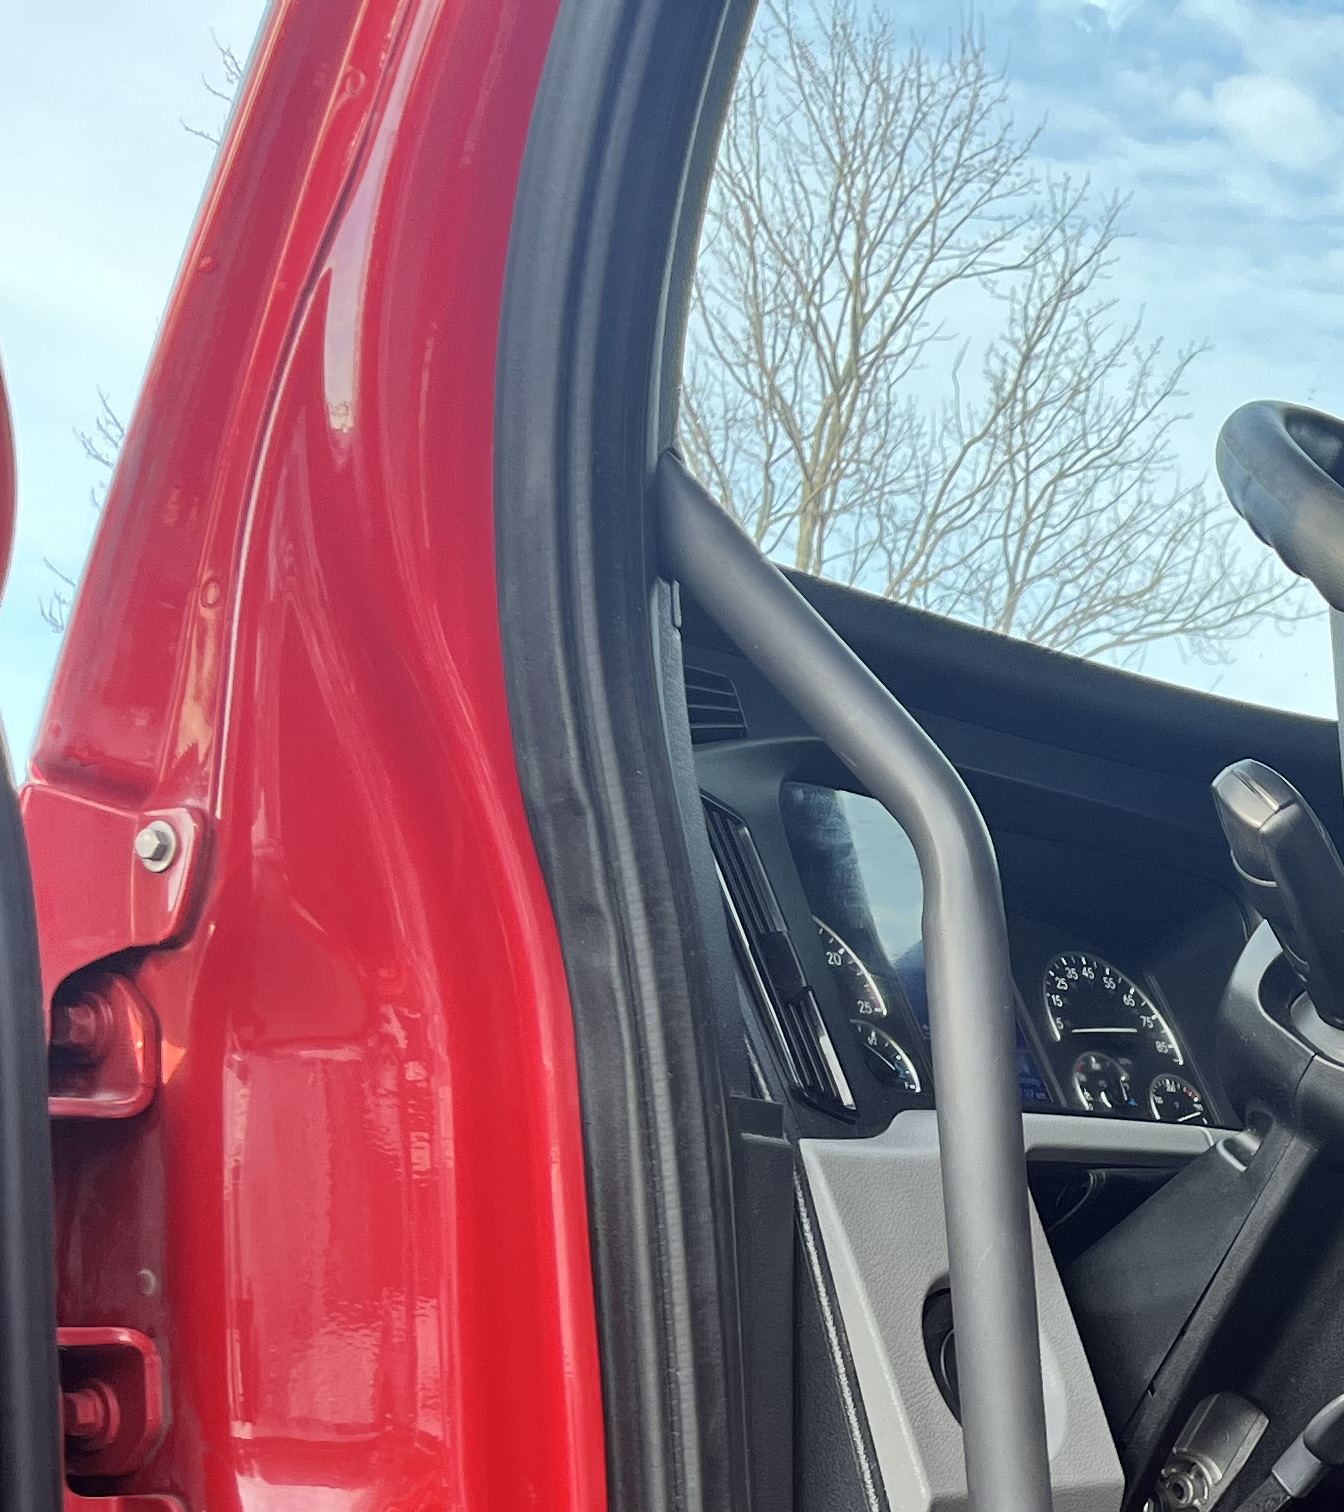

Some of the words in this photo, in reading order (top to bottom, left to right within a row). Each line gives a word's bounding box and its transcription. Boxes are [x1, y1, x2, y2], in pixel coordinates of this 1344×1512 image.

[826, 951, 842, 966] 20
[1065, 967, 1078, 980] 35
[1082, 966, 1095, 980] 45
[1054, 977, 1068, 991] 25
[1103, 976, 1116, 990] 55
[857, 1000, 873, 1014] 25
[1051, 994, 1063, 1008] 15
[1122, 994, 1135, 1007] 65
[1056, 1017, 1064, 1030] 5
[1139, 1015, 1153, 1029] 75
